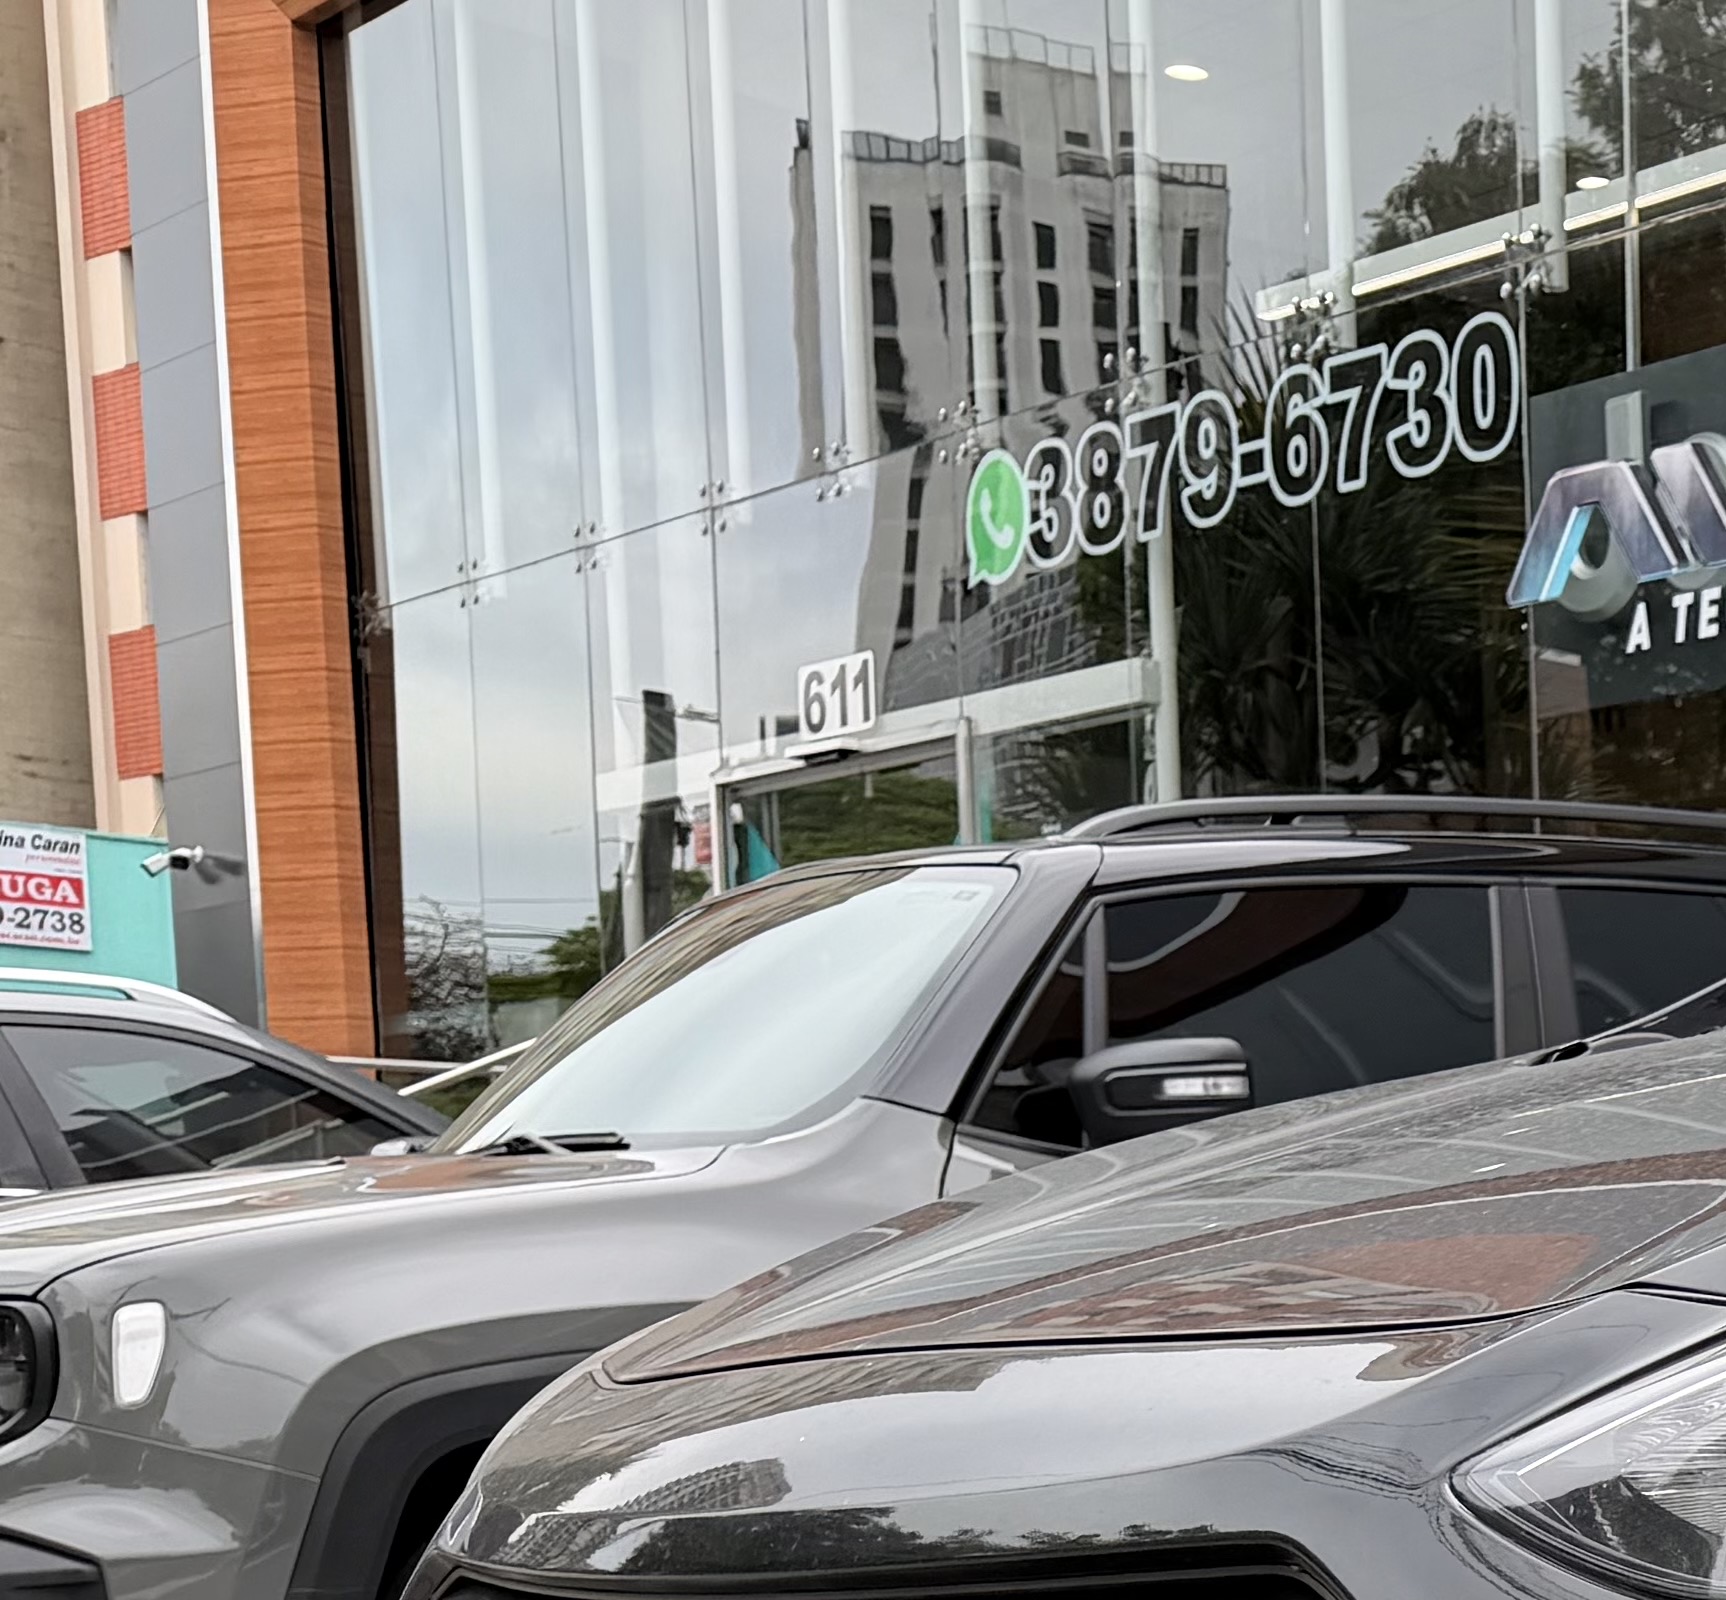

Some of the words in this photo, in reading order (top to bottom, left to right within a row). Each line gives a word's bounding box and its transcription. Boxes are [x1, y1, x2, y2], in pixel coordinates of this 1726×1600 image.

[1025, 311, 1521, 568] 3879-6730
[1625, 603, 1652, 655] A
[803, 658, 872, 735] 611
[31, 833, 80, 855] Caran
